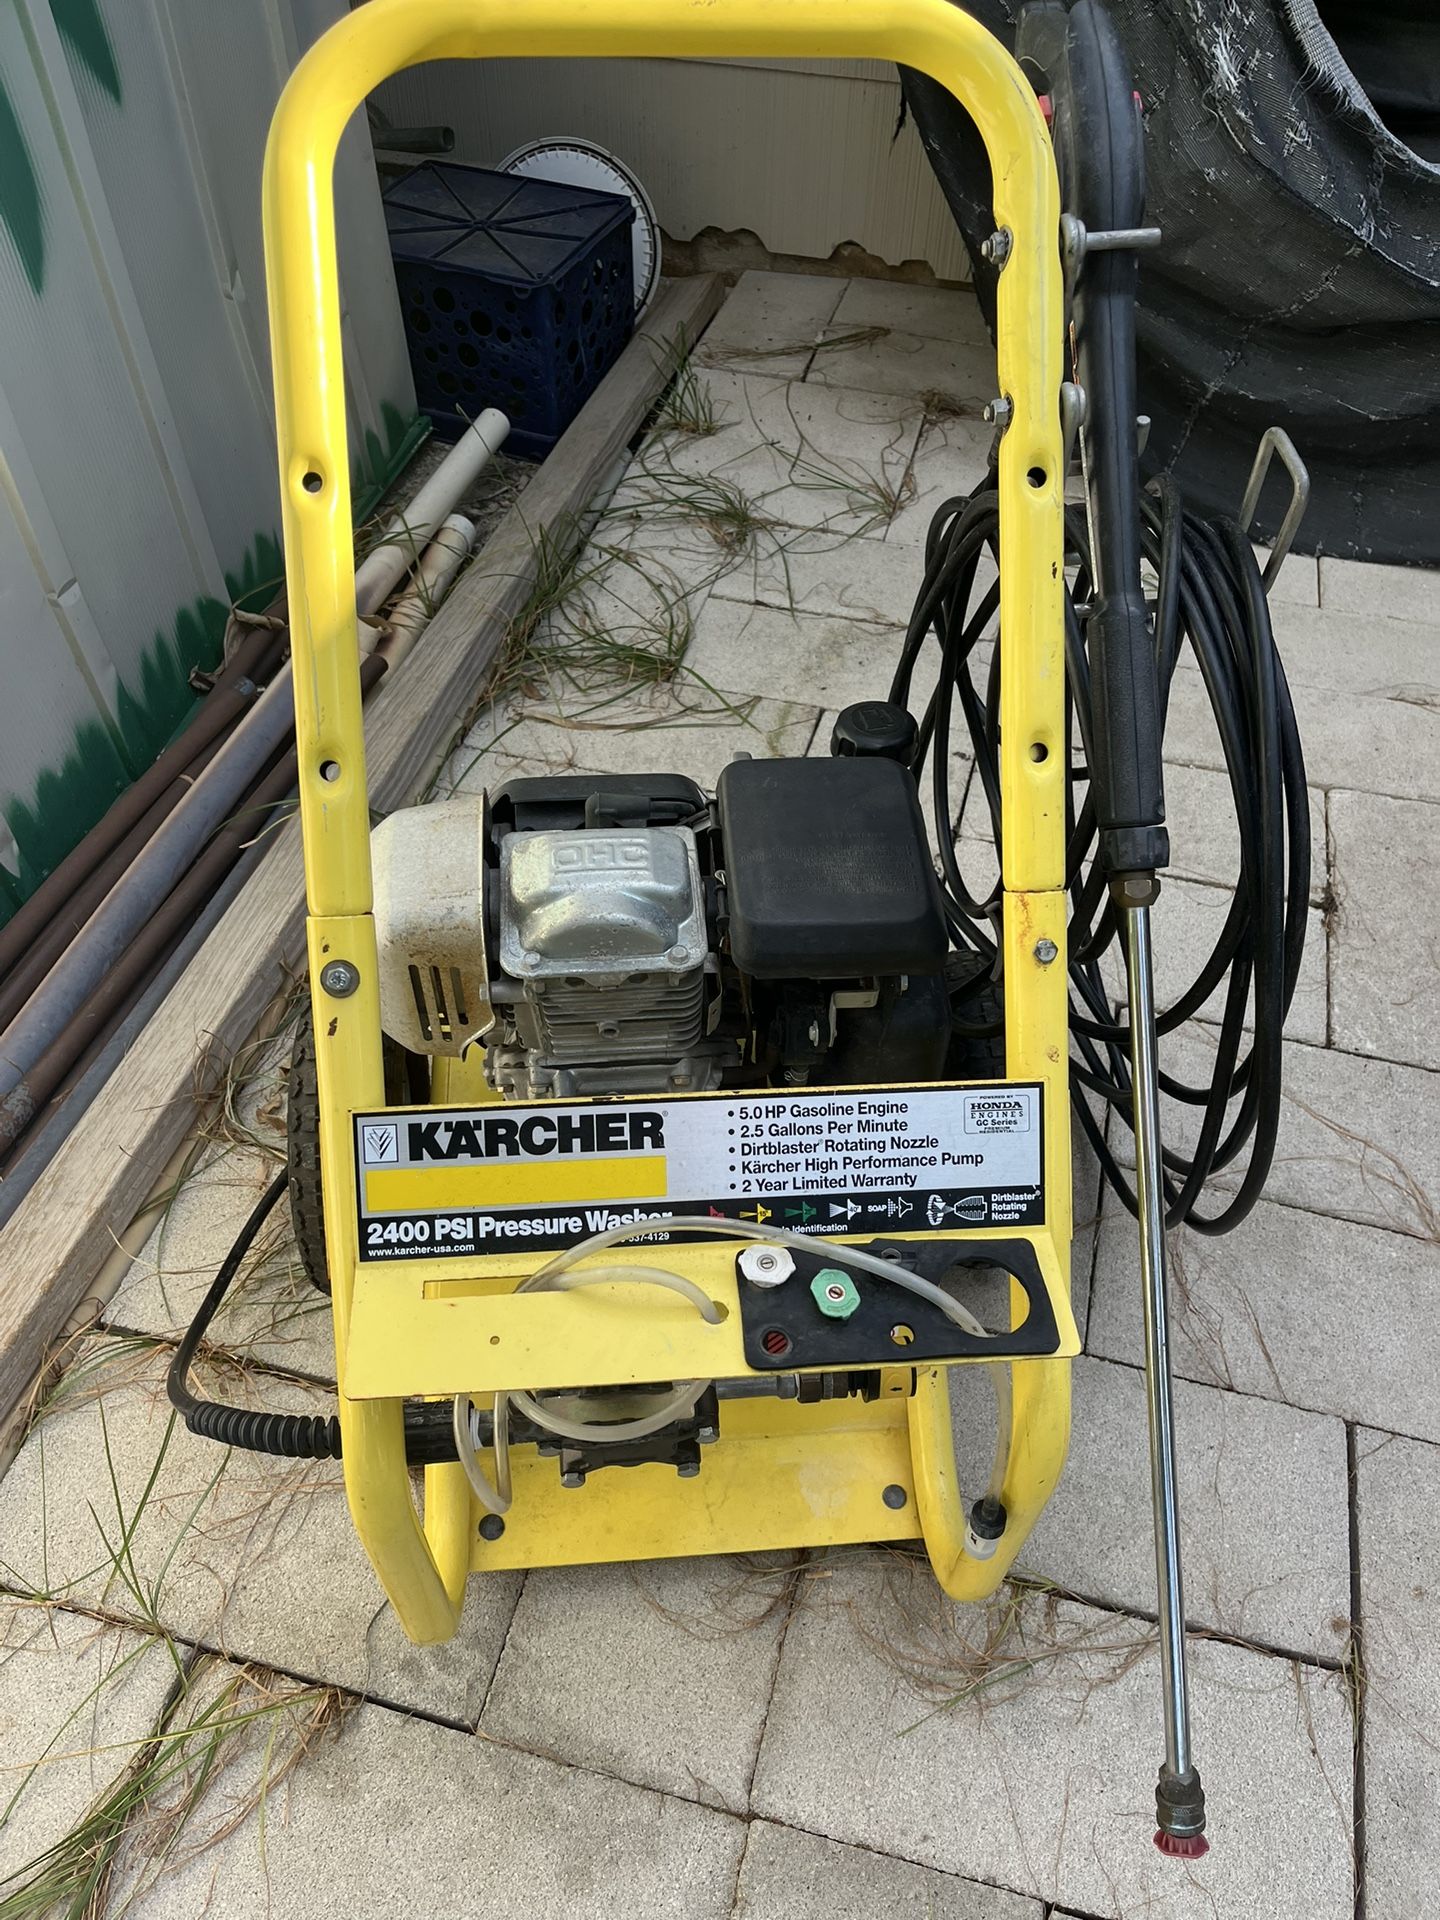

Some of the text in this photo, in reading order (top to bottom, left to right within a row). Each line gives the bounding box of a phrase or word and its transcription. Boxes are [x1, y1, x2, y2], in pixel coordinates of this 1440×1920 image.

[552, 844, 648, 868] OHC
[739, 1101, 909, 1120] 5.0 HP Gasoline Engine
[970, 1101, 1023, 1110] HONDA
[970, 1111, 1024, 1119] ENGINES
[740, 1119, 909, 1138] 2.5 Gallons Per Minute
[976, 1119, 989, 1127] GC
[408, 1111, 665, 1161] KÄRCHER
[741, 1135, 939, 1156] Dirtblaster Rotating Nozzle
[741, 1152, 984, 1174] Kärcher High Performance Pump
[742, 1172, 918, 1192] 2 Year Limited Warranty
[991, 1193, 1036, 1201] Dirtblaster
[867, 1204, 887, 1212] SOAP
[991, 1202, 1027, 1212] Rotating
[991, 1212, 1020, 1221] Nozzle
[367, 1220, 430, 1245] 2400
[434, 1217, 474, 1241] PSI
[479, 1214, 583, 1238] Pressure
[792, 1223, 848, 1233] Identification
[368, 1243, 475, 1257] www.karcher-usa.com
